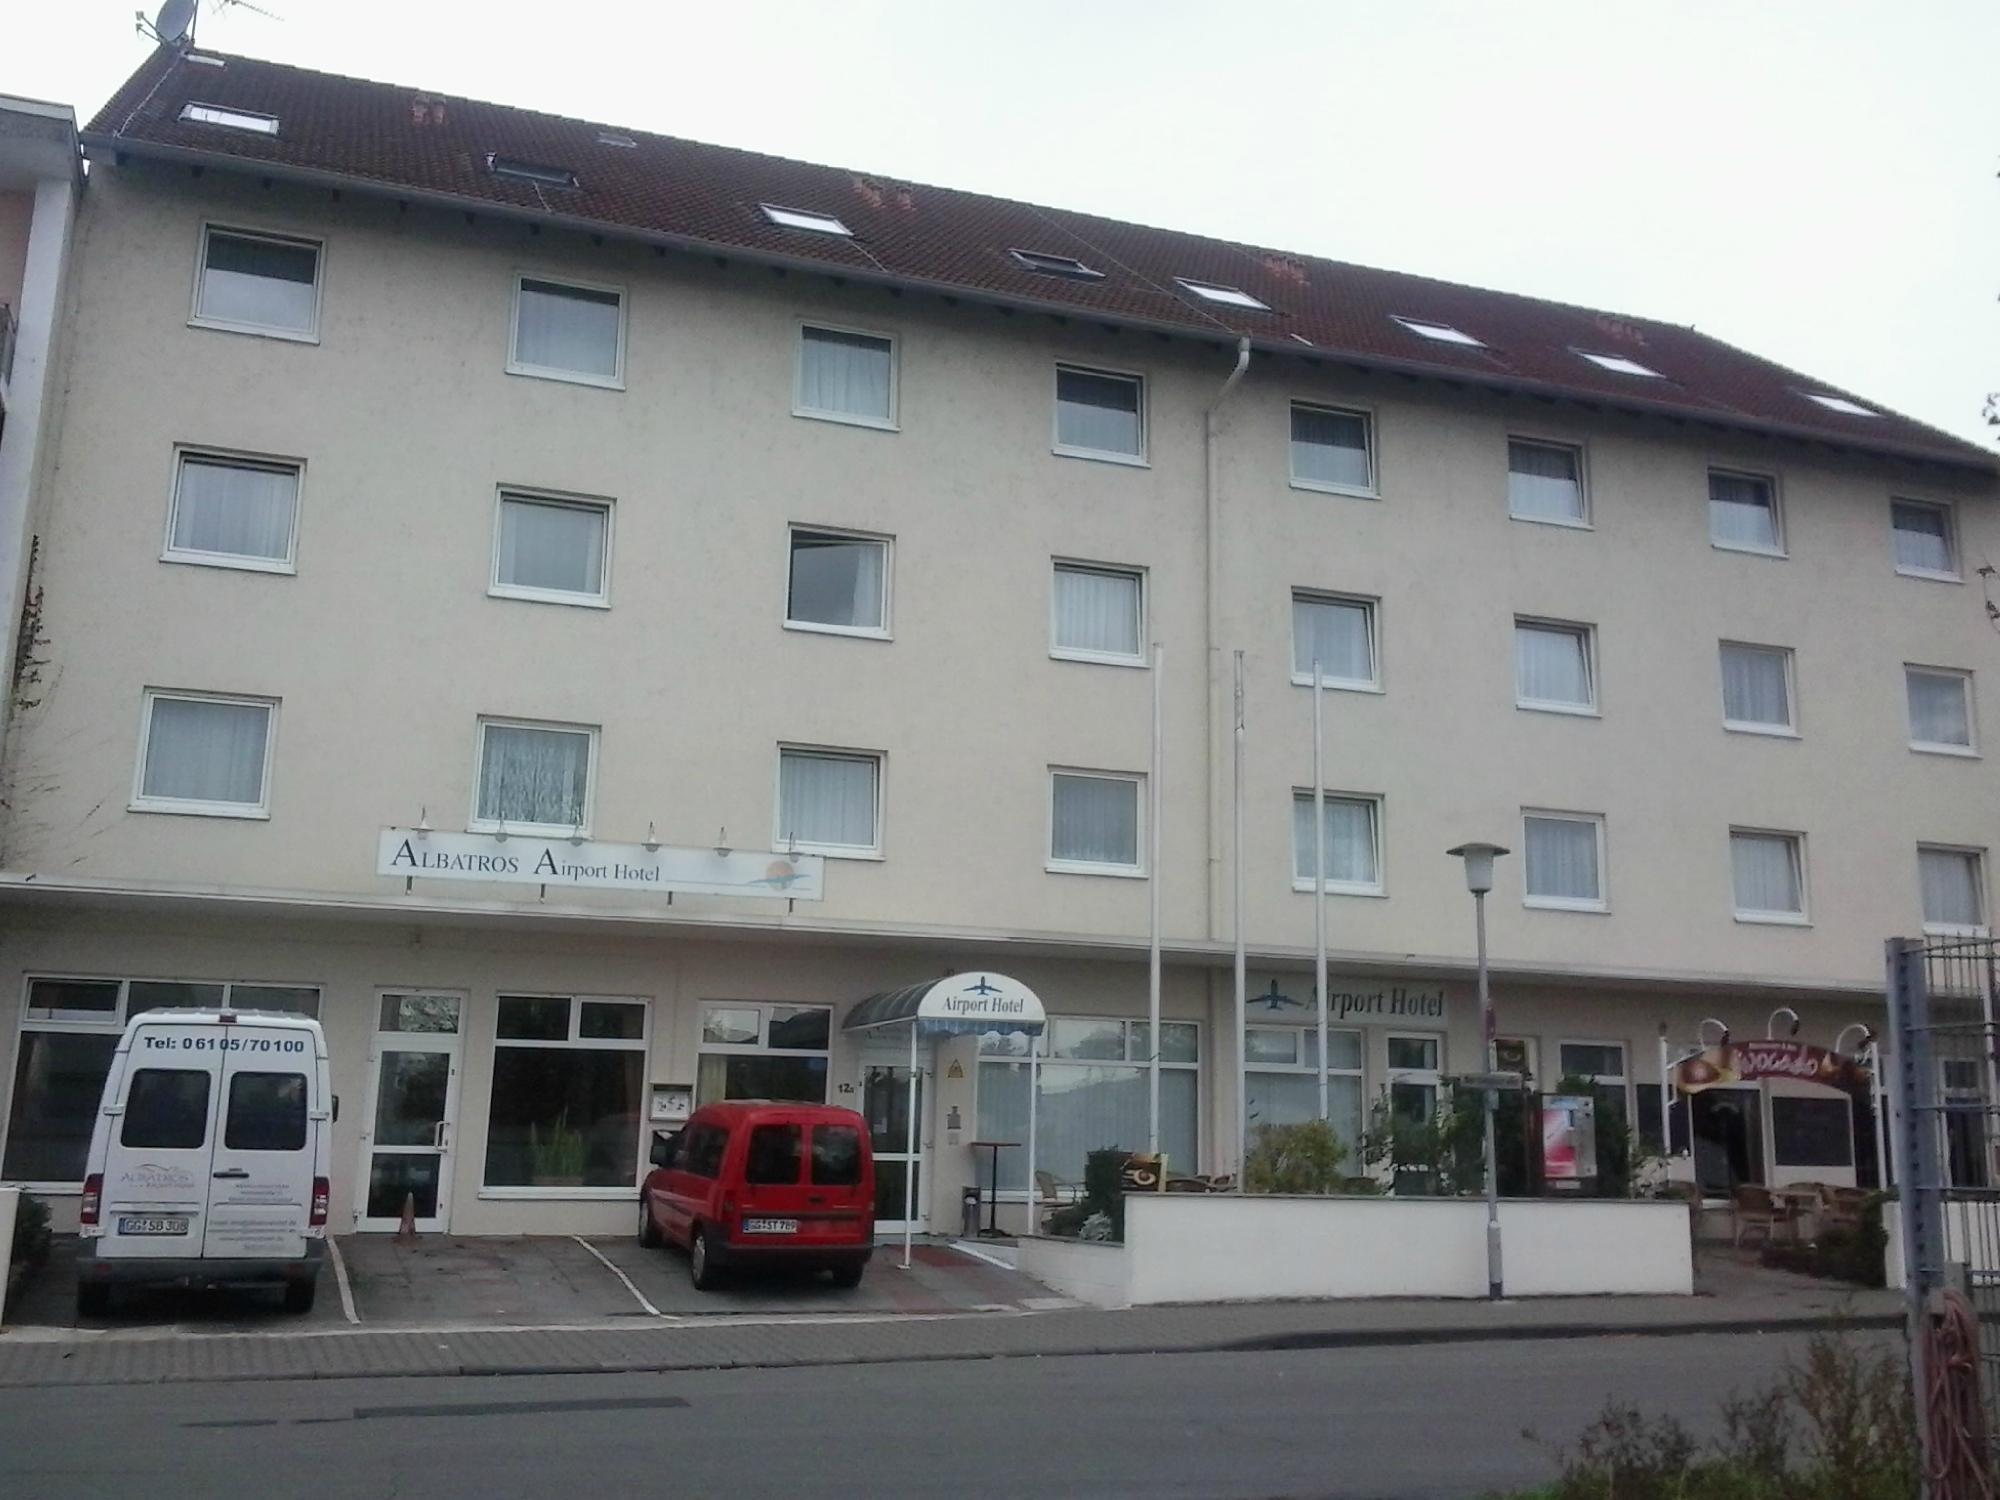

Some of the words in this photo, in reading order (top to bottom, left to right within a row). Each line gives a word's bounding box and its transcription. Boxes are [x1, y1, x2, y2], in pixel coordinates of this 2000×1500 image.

[390, 838, 520, 874] ALBATROS
[534, 847, 607, 881] Airport
[614, 863, 660, 882] Hotel
[942, 996, 988, 1015] Airport
[991, 997, 1024, 1013] Hotel
[1390, 986, 1444, 1017] Hotel
[144, 1036, 176, 1049] Tel:
